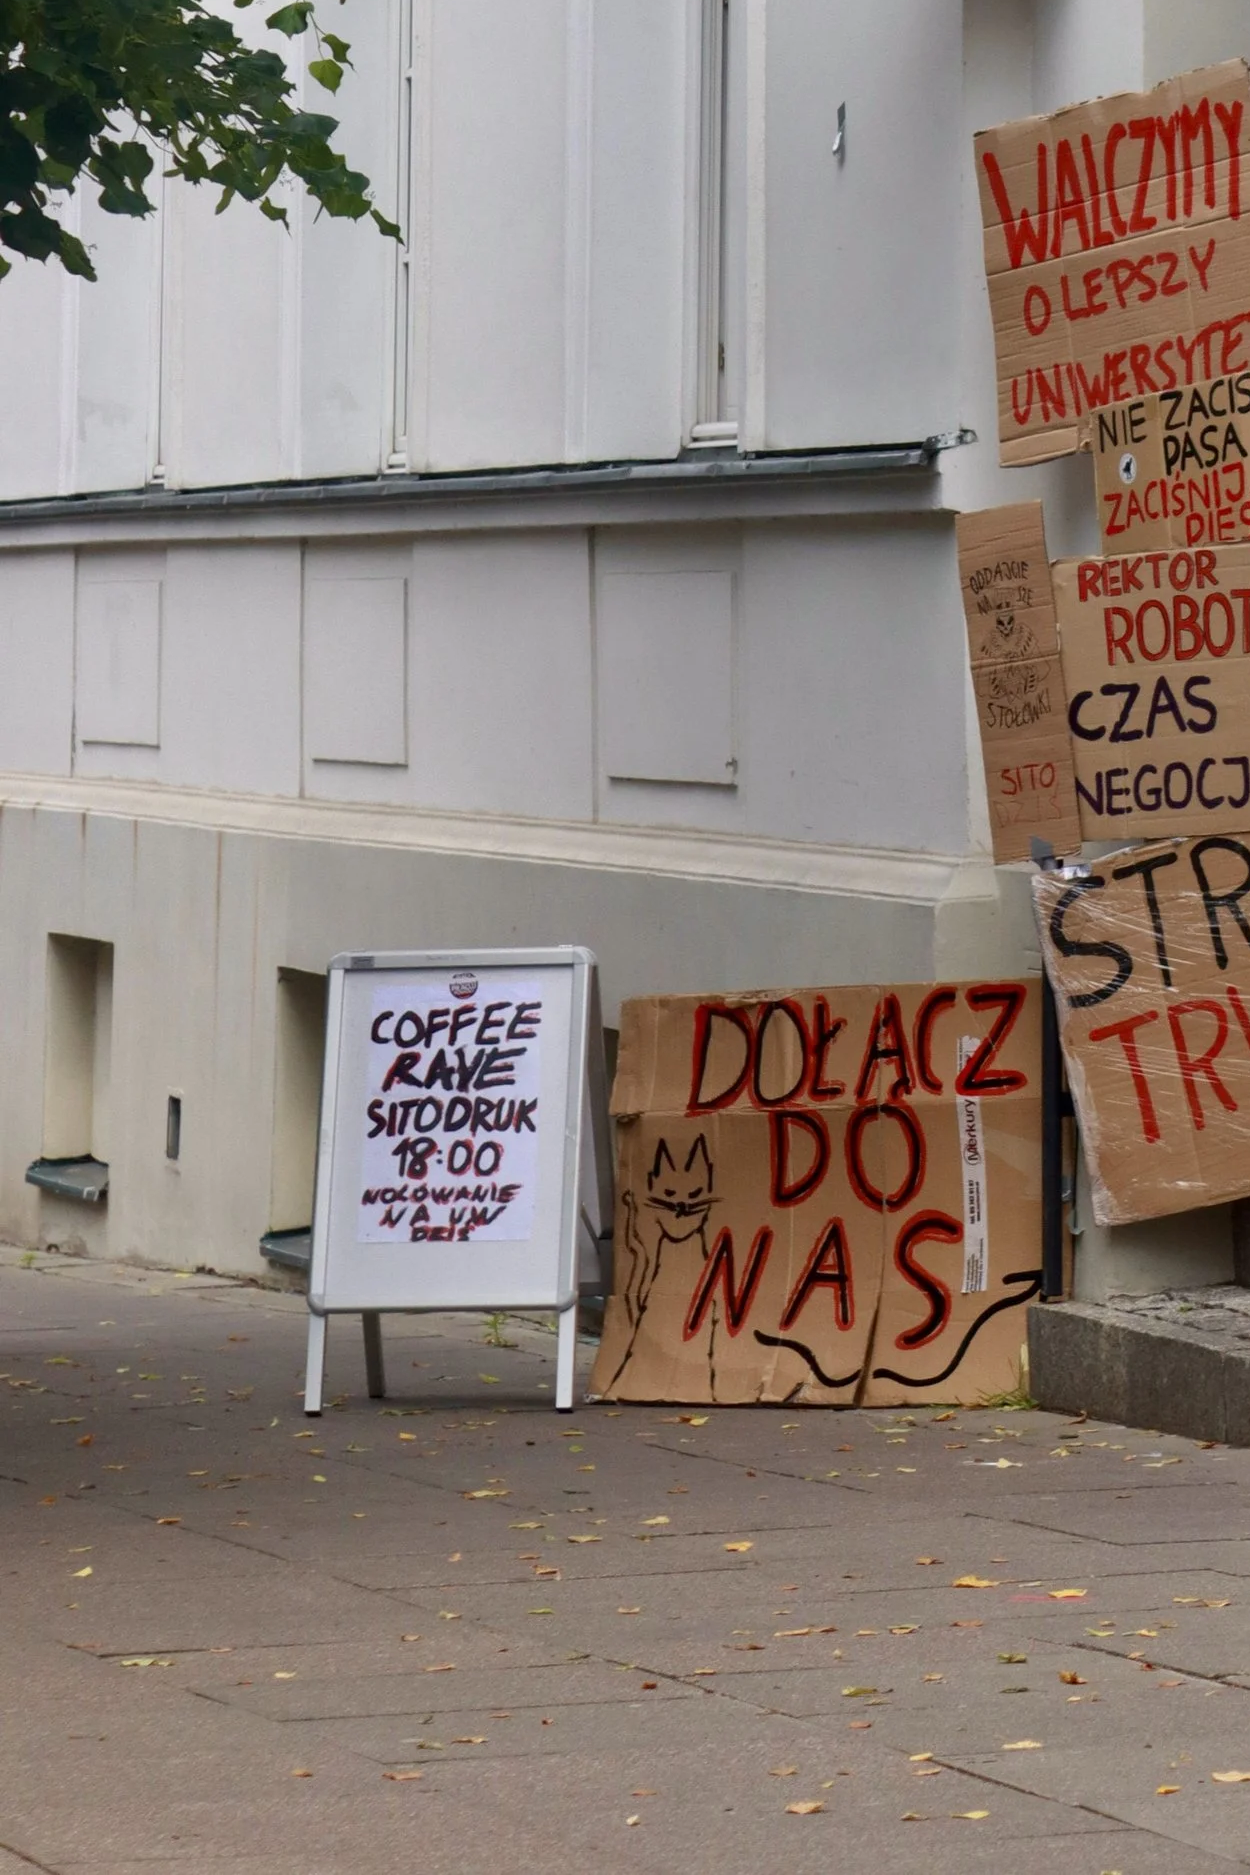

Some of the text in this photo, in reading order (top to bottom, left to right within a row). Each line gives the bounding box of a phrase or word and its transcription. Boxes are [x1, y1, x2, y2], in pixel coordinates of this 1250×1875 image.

[982, 96, 1244, 269] WALCZYMY
[1023, 237, 1217, 336] O LEPSZY
[1098, 401, 1148, 453] NIE
[1163, 421, 1249, 476] PASA
[1103, 461, 1246, 537] ZACIŚNIJ
[1077, 549, 1219, 603] REKTOR
[1068, 675, 1218, 745] CZAS
[1001, 761, 1056, 796] SITO
[370, 1000, 543, 1049] COFFEE
[685, 983, 1027, 1118] DOŁĄCZ
[381, 1046, 528, 1094] RAVE
[366, 1095, 539, 1140] SITODRUK
[964, 1099, 980, 1162] Merkury
[391, 1135, 503, 1181] 18:00
[769, 1102, 928, 1213] DO
[378, 1203, 431, 1229] NA
[682, 1209, 964, 1351] NAS
